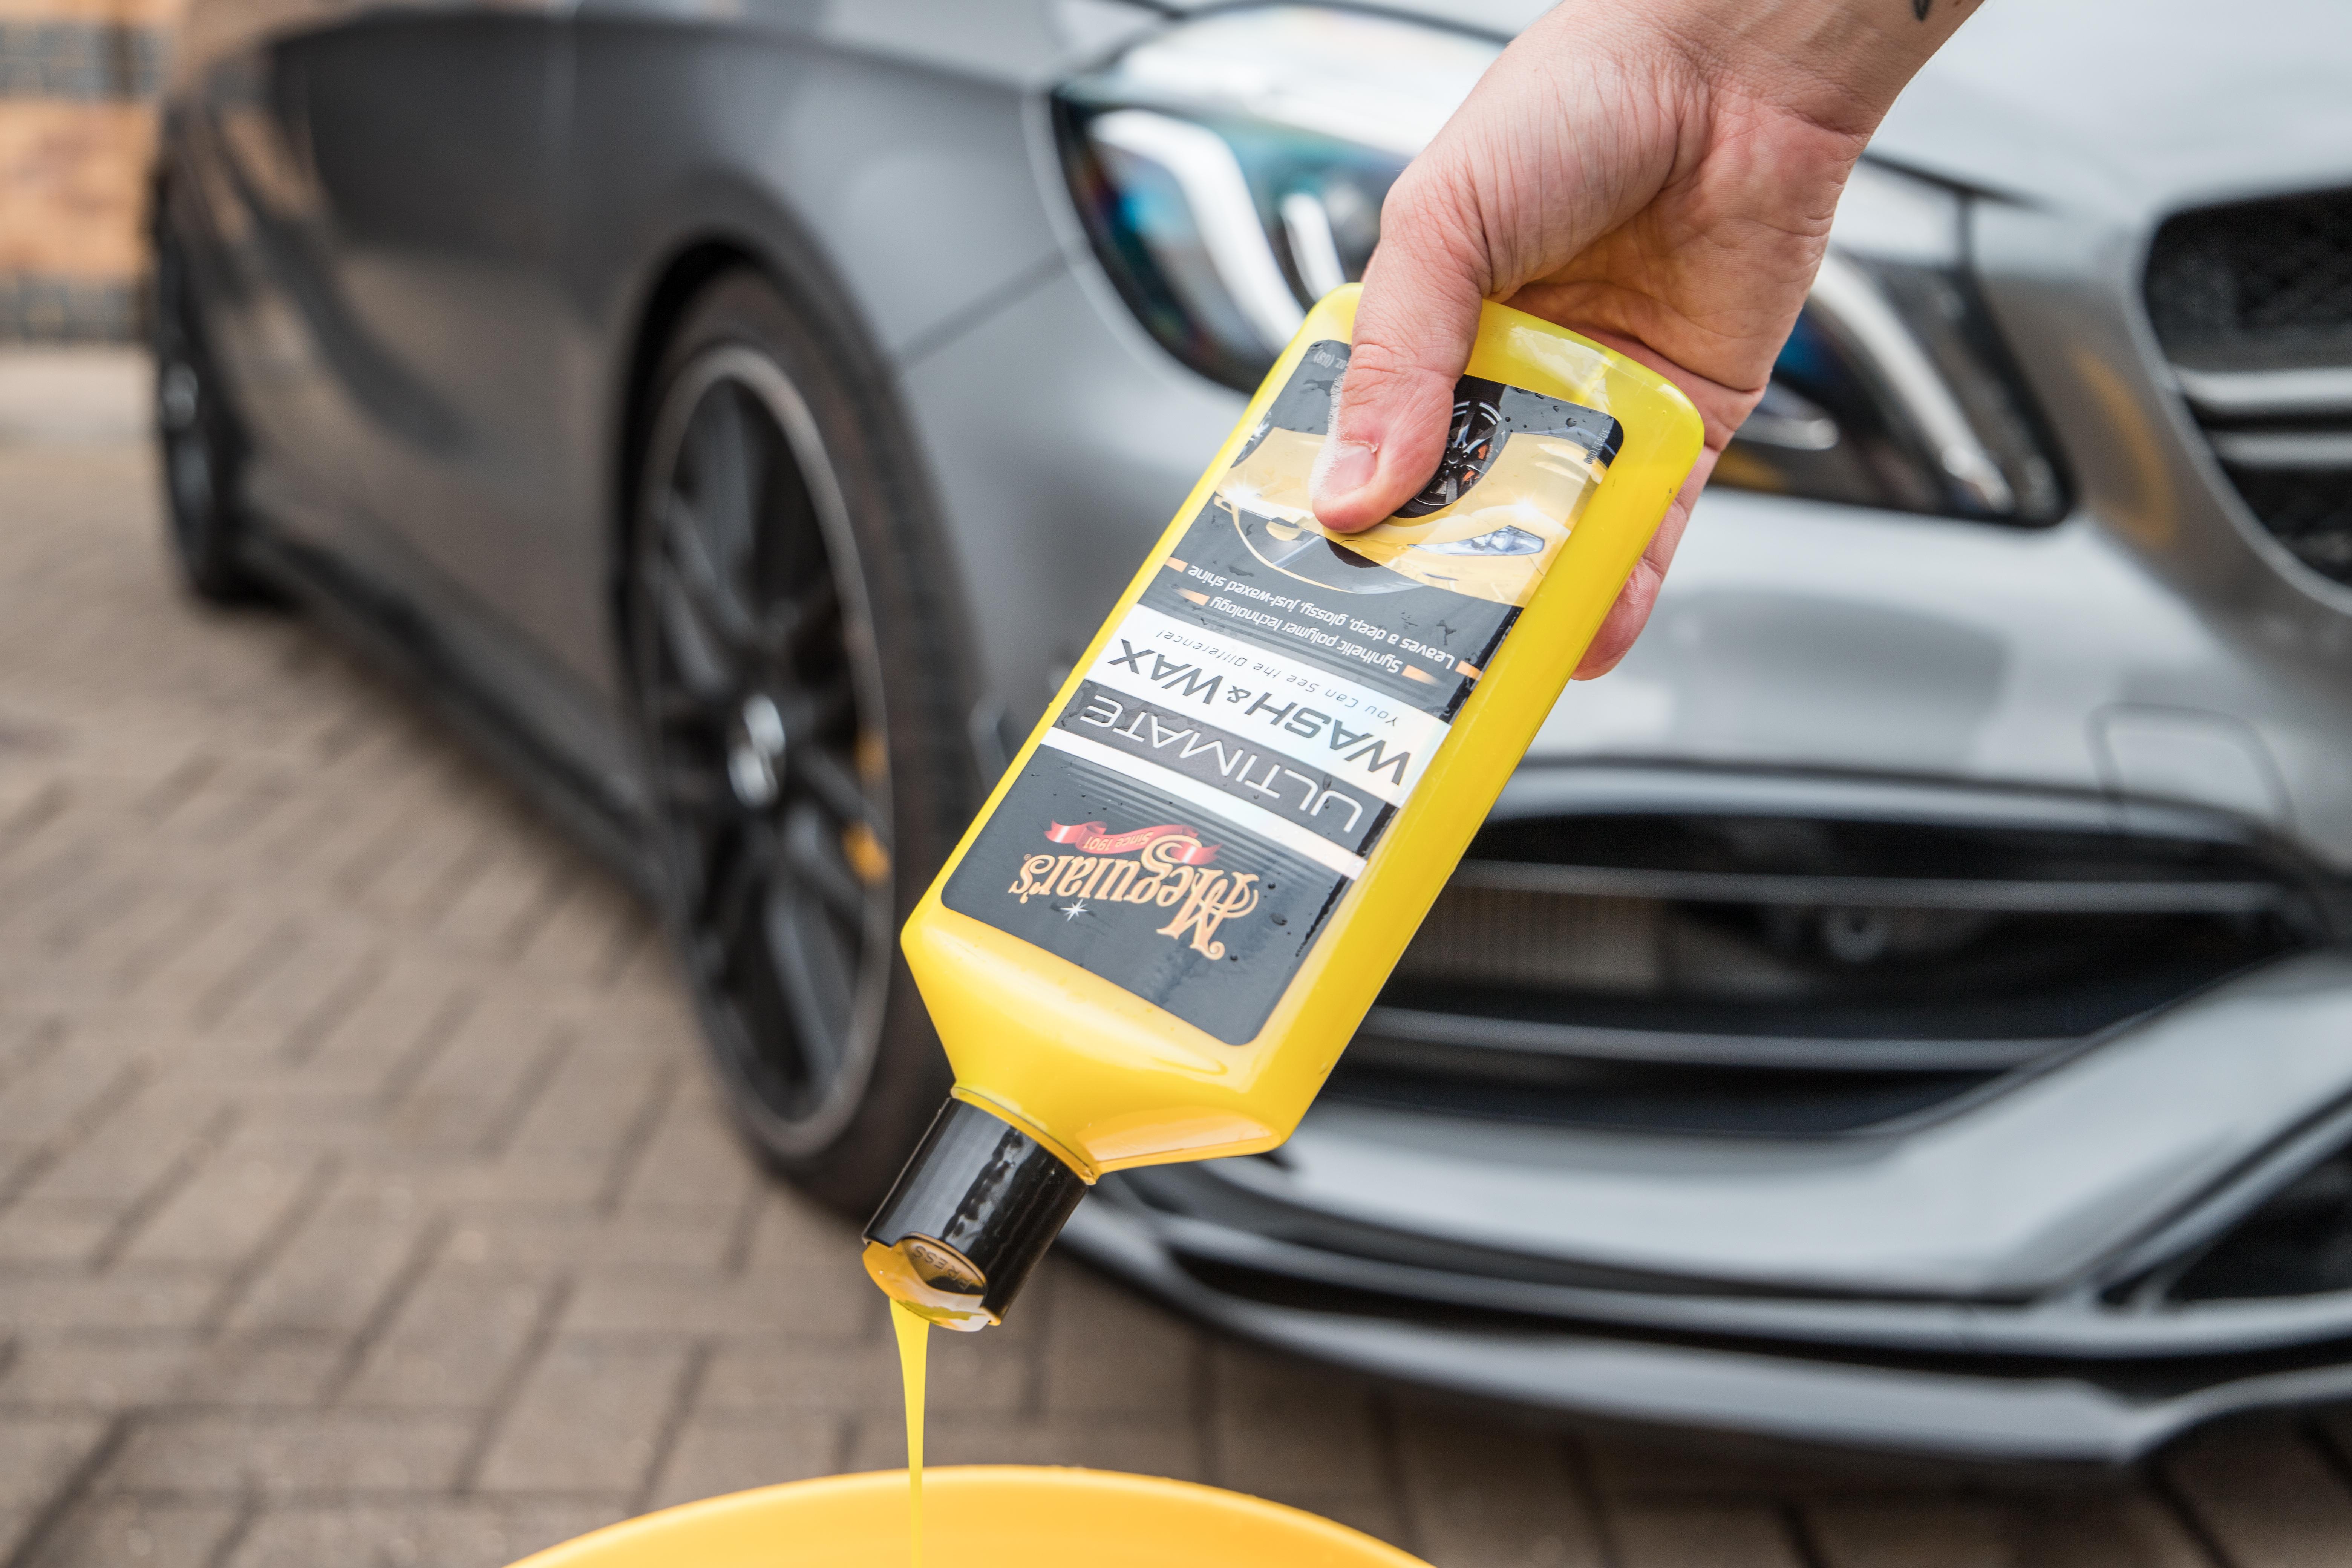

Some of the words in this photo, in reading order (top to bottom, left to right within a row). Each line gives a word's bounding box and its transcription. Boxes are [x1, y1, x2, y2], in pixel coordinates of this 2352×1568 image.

[1313, 349, 1335, 368] (US)
[1583, 428, 1611, 464] 30811000
[1188, 565, 1227, 587] shine
[1223, 581, 1301, 612] just-waxed
[1209, 596, 1283, 631] technology
[1300, 602, 1349, 626] glossy,
[1282, 622, 1340, 647] polymer
[1349, 618, 1387, 641] deep,
[1387, 633, 1400, 645] a
[1156, 629, 1248, 667] Difference!
[1337, 640, 1403, 673] Synthetic
[1399, 638, 1455, 670] Leaves
[1107, 638, 1224, 706] WAX
[1253, 662, 1282, 679] the
[1227, 685, 1251, 704] &
[1286, 673, 1320, 693] See
[1325, 688, 1359, 709] Can
[1365, 705, 1398, 727] You
[1244, 691, 1411, 786] WASH
[1080, 694, 1363, 833] ULTIMATE
[1084, 835, 1112, 852] 1901
[1115, 831, 1154, 850] Since
[1008, 834, 1260, 960] Meguiar's
[912, 1246, 972, 1291] PRESS
